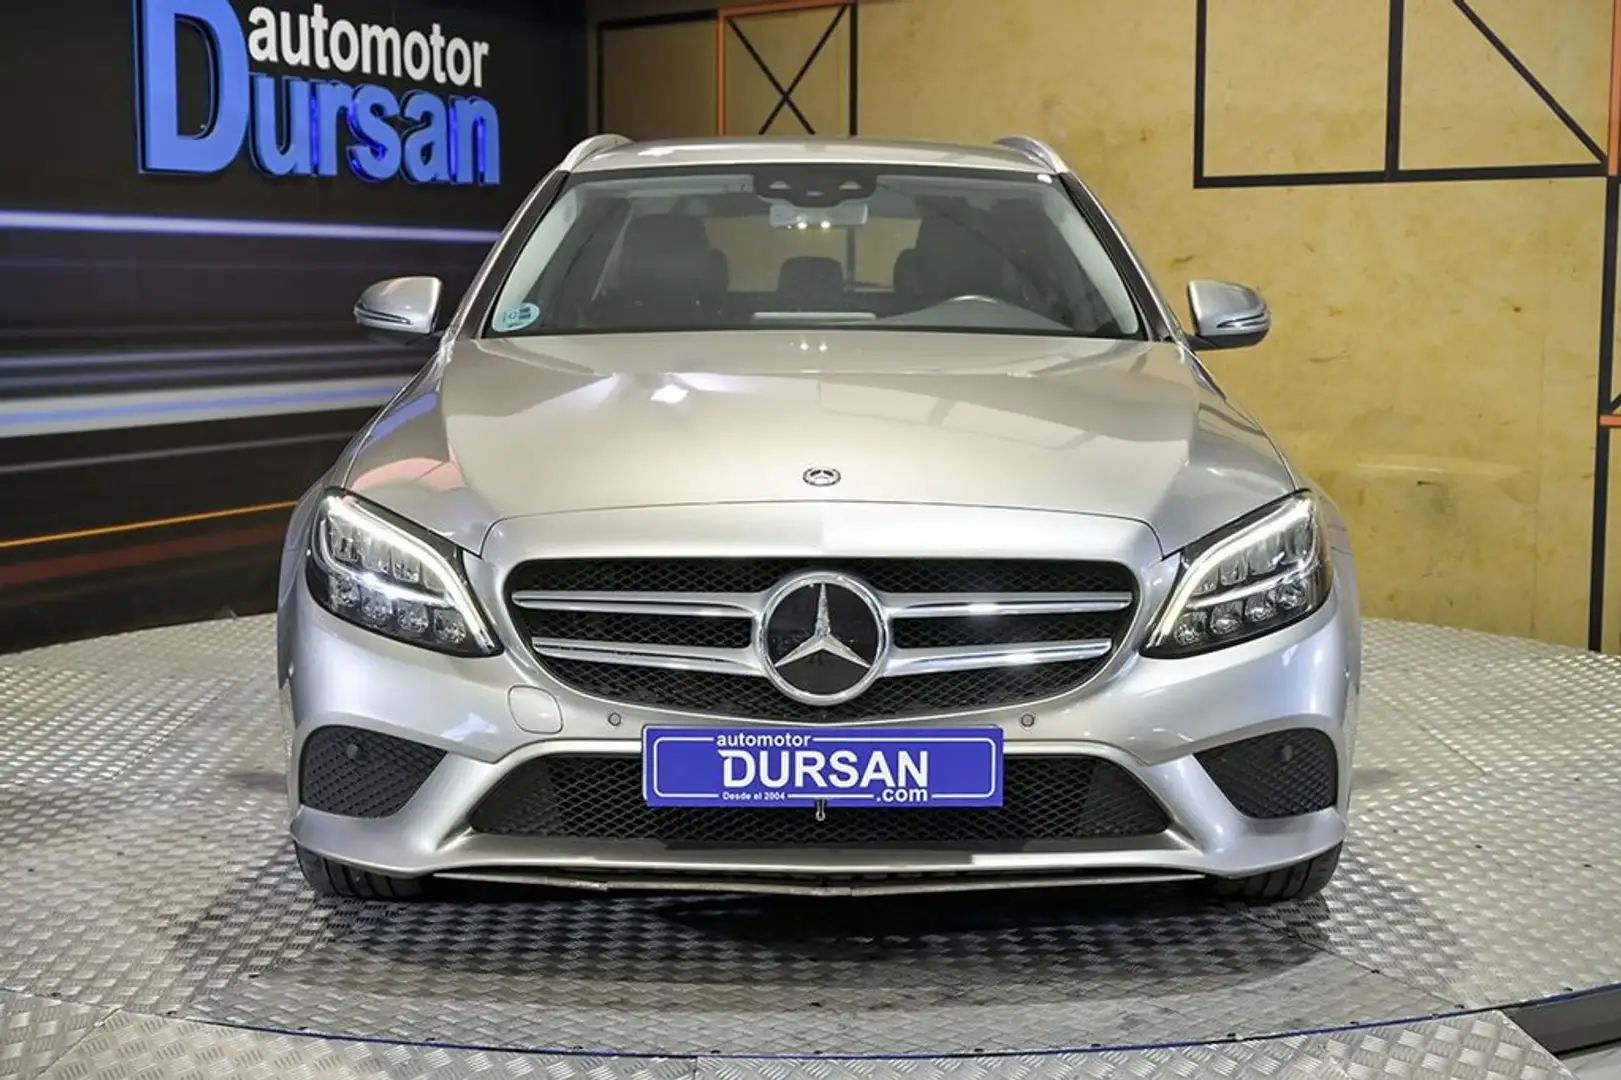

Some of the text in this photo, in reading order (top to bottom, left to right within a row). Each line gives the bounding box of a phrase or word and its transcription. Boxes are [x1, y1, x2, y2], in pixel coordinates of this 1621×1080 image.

[247, 4, 490, 88] automotor
[135, 0, 500, 186] Dursan
[716, 732, 812, 747] automotor
[717, 749, 929, 789] DURSAN
[876, 787, 929, 803] .com
